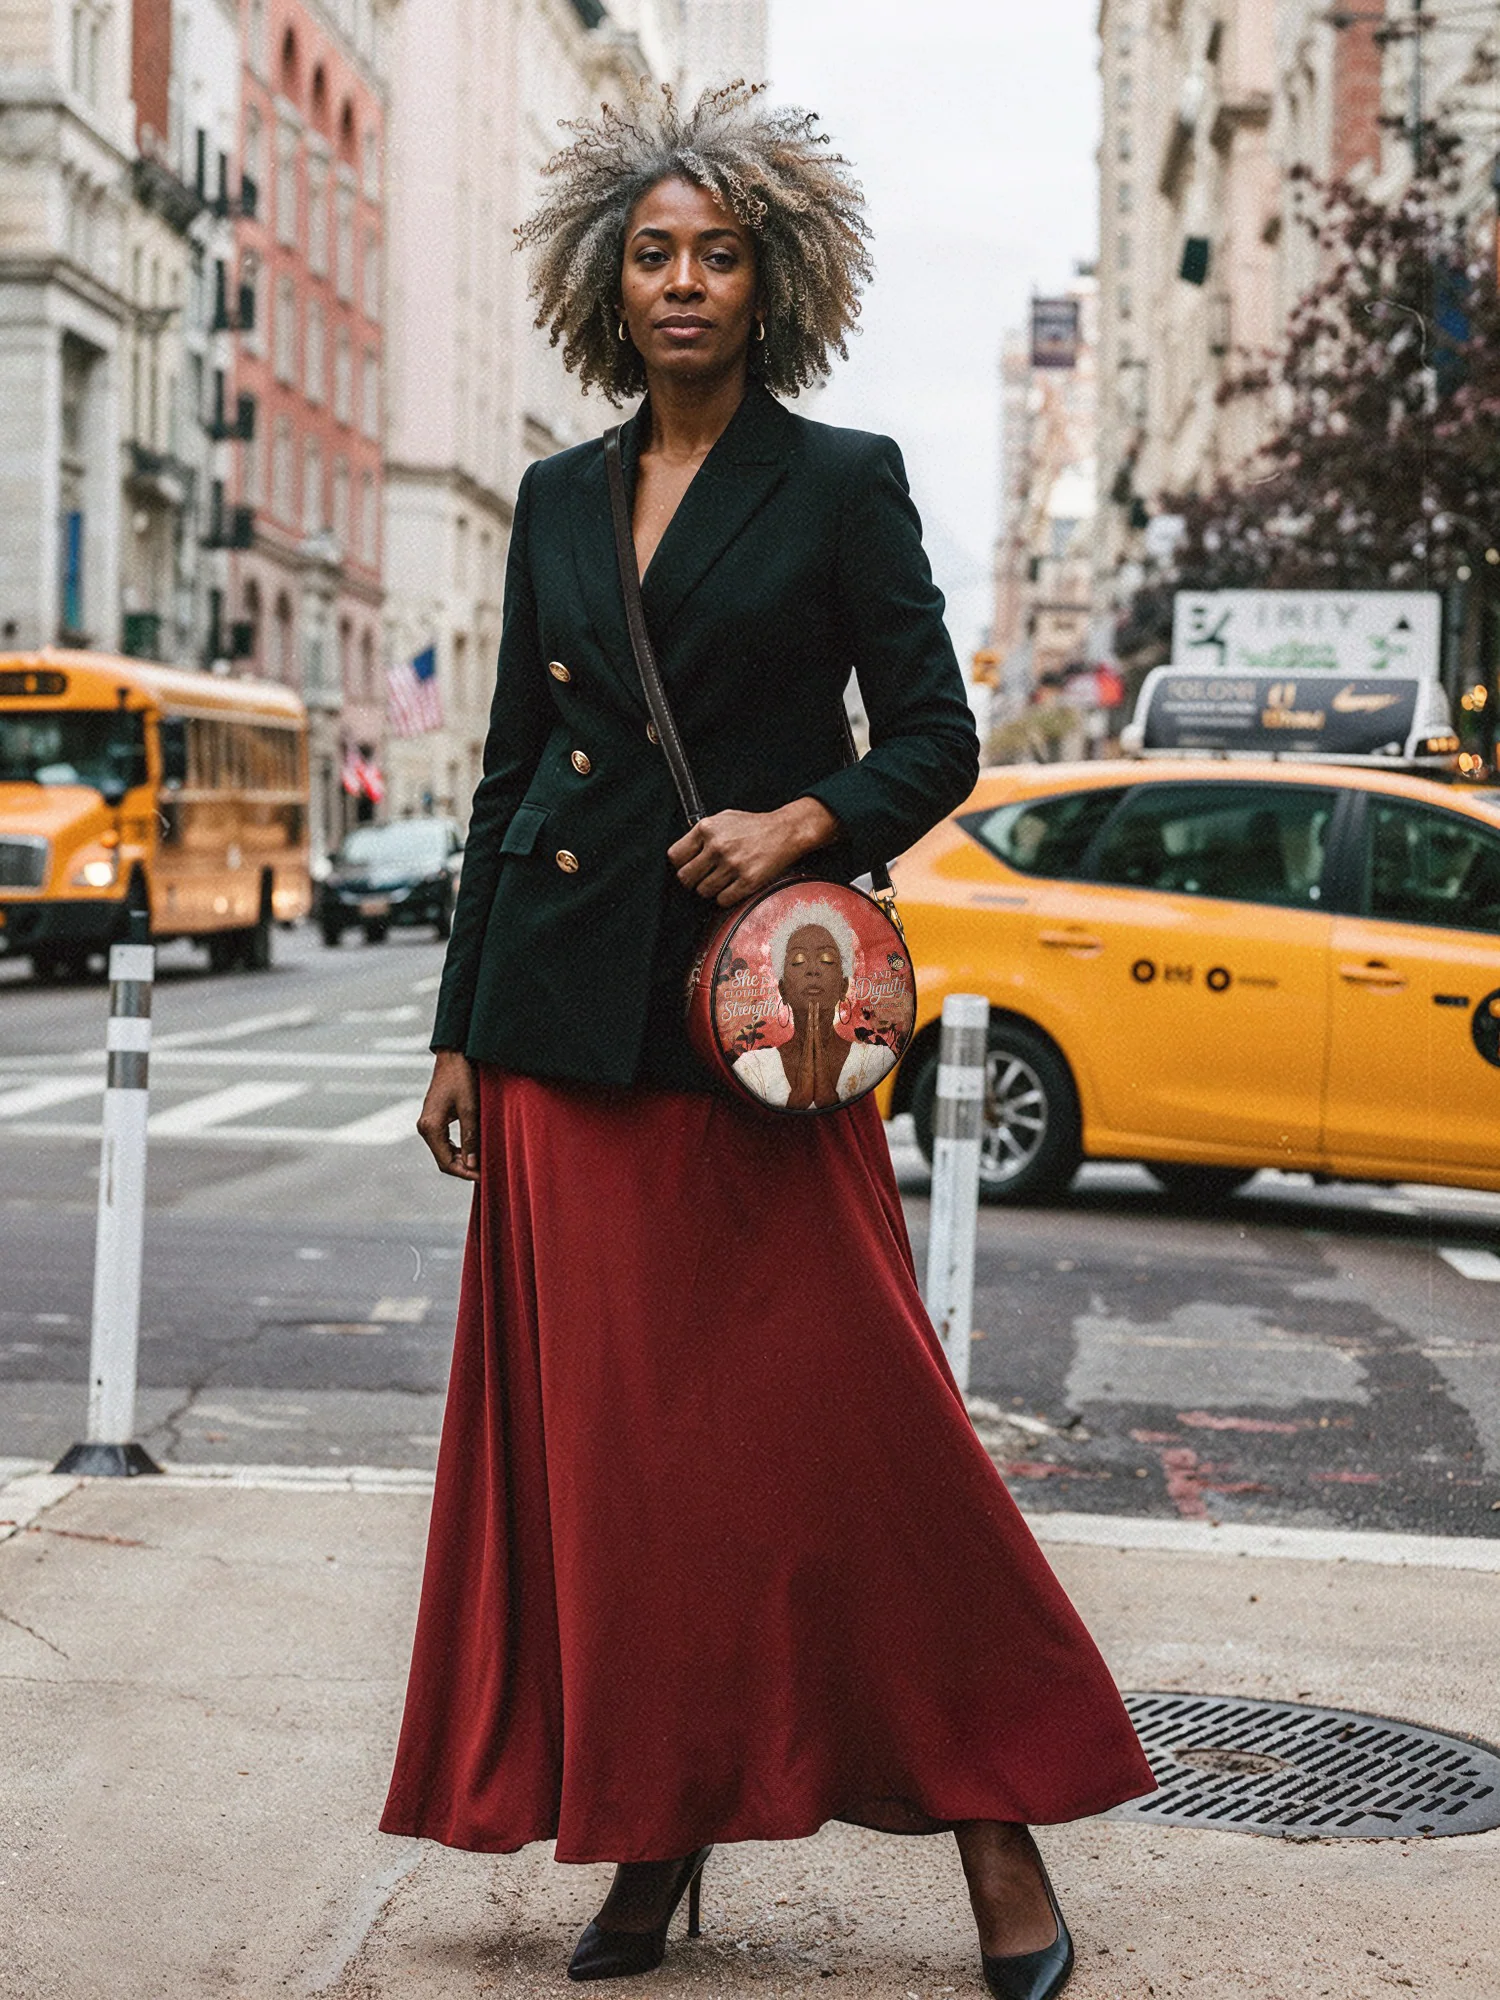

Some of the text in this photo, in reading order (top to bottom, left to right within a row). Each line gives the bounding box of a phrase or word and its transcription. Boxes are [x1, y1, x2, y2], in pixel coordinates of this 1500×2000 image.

[731, 969, 759, 988] She
[855, 976, 907, 1005] Dignity
[721, 995, 777, 1022] Strength
